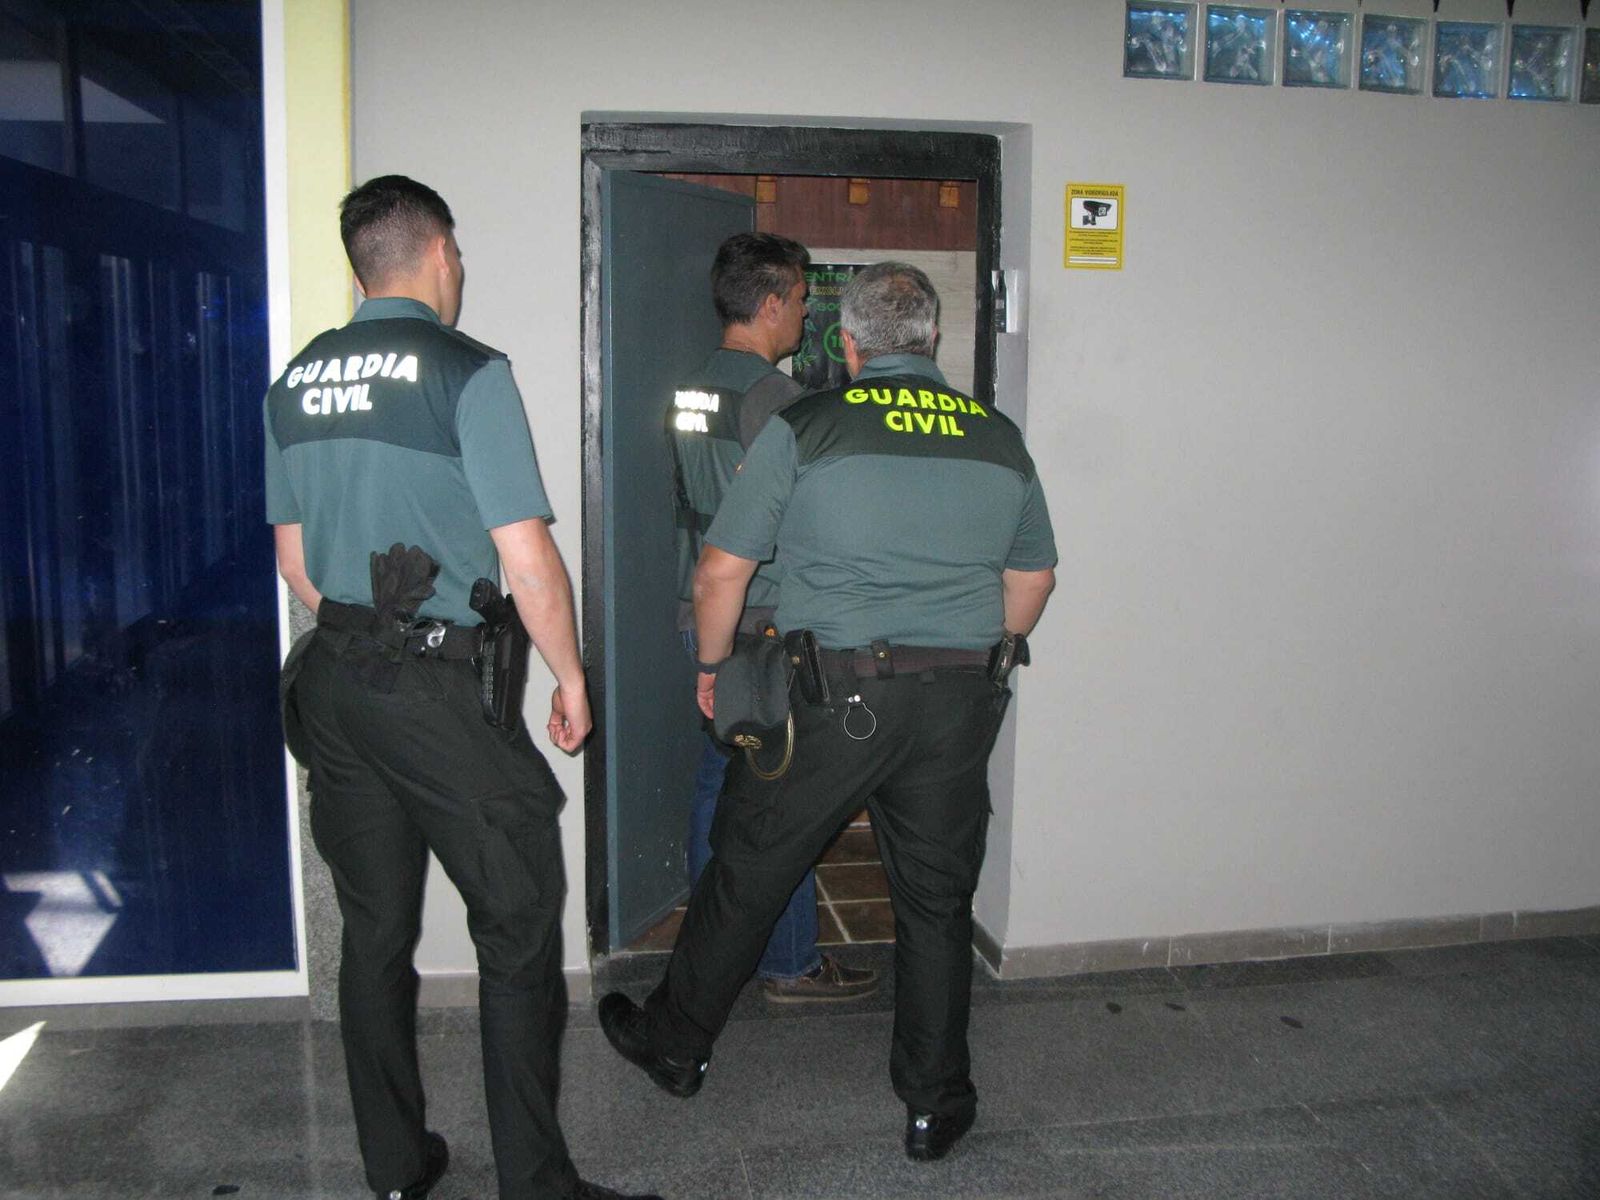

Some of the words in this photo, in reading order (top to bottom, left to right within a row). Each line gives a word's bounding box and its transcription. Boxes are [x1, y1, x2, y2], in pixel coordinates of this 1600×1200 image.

[287, 353, 418, 388] GUARDIA
[302, 383, 373, 415] CIVIL
[845, 388, 988, 418] GUARDIA
[885, 410, 964, 437] CIVIL
